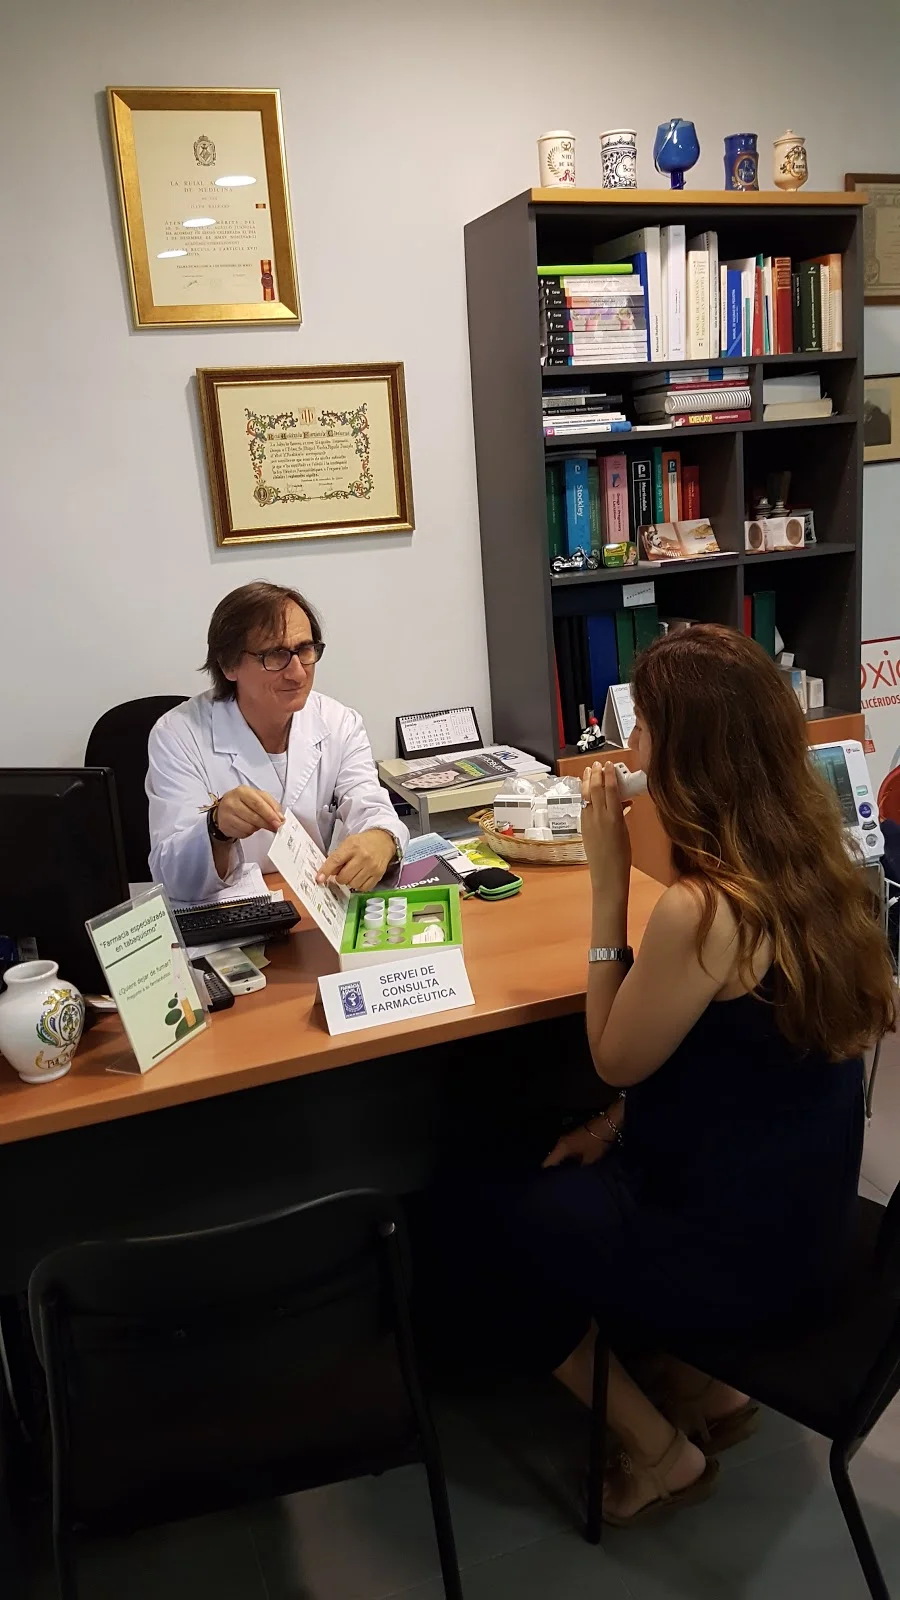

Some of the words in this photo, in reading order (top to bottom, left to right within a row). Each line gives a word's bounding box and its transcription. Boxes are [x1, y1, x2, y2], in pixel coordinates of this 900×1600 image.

[576, 484, 585, 517] Stockley
[860, 694, 900, 710] LICÉRIDOS
[130, 910, 166, 935] especializada
[115, 943, 123, 952] en
[118, 979, 137, 996] ¿Quiere
[137, 972, 149, 986] dejar
[150, 968, 156, 977] de
[156, 959, 171, 975] fumar?
[380, 971, 418, 985] SERVEI
[420, 965, 436, 976] DE
[382, 978, 439, 998] CONSULTA
[372, 987, 457, 1013] FARMACÈUTICA
